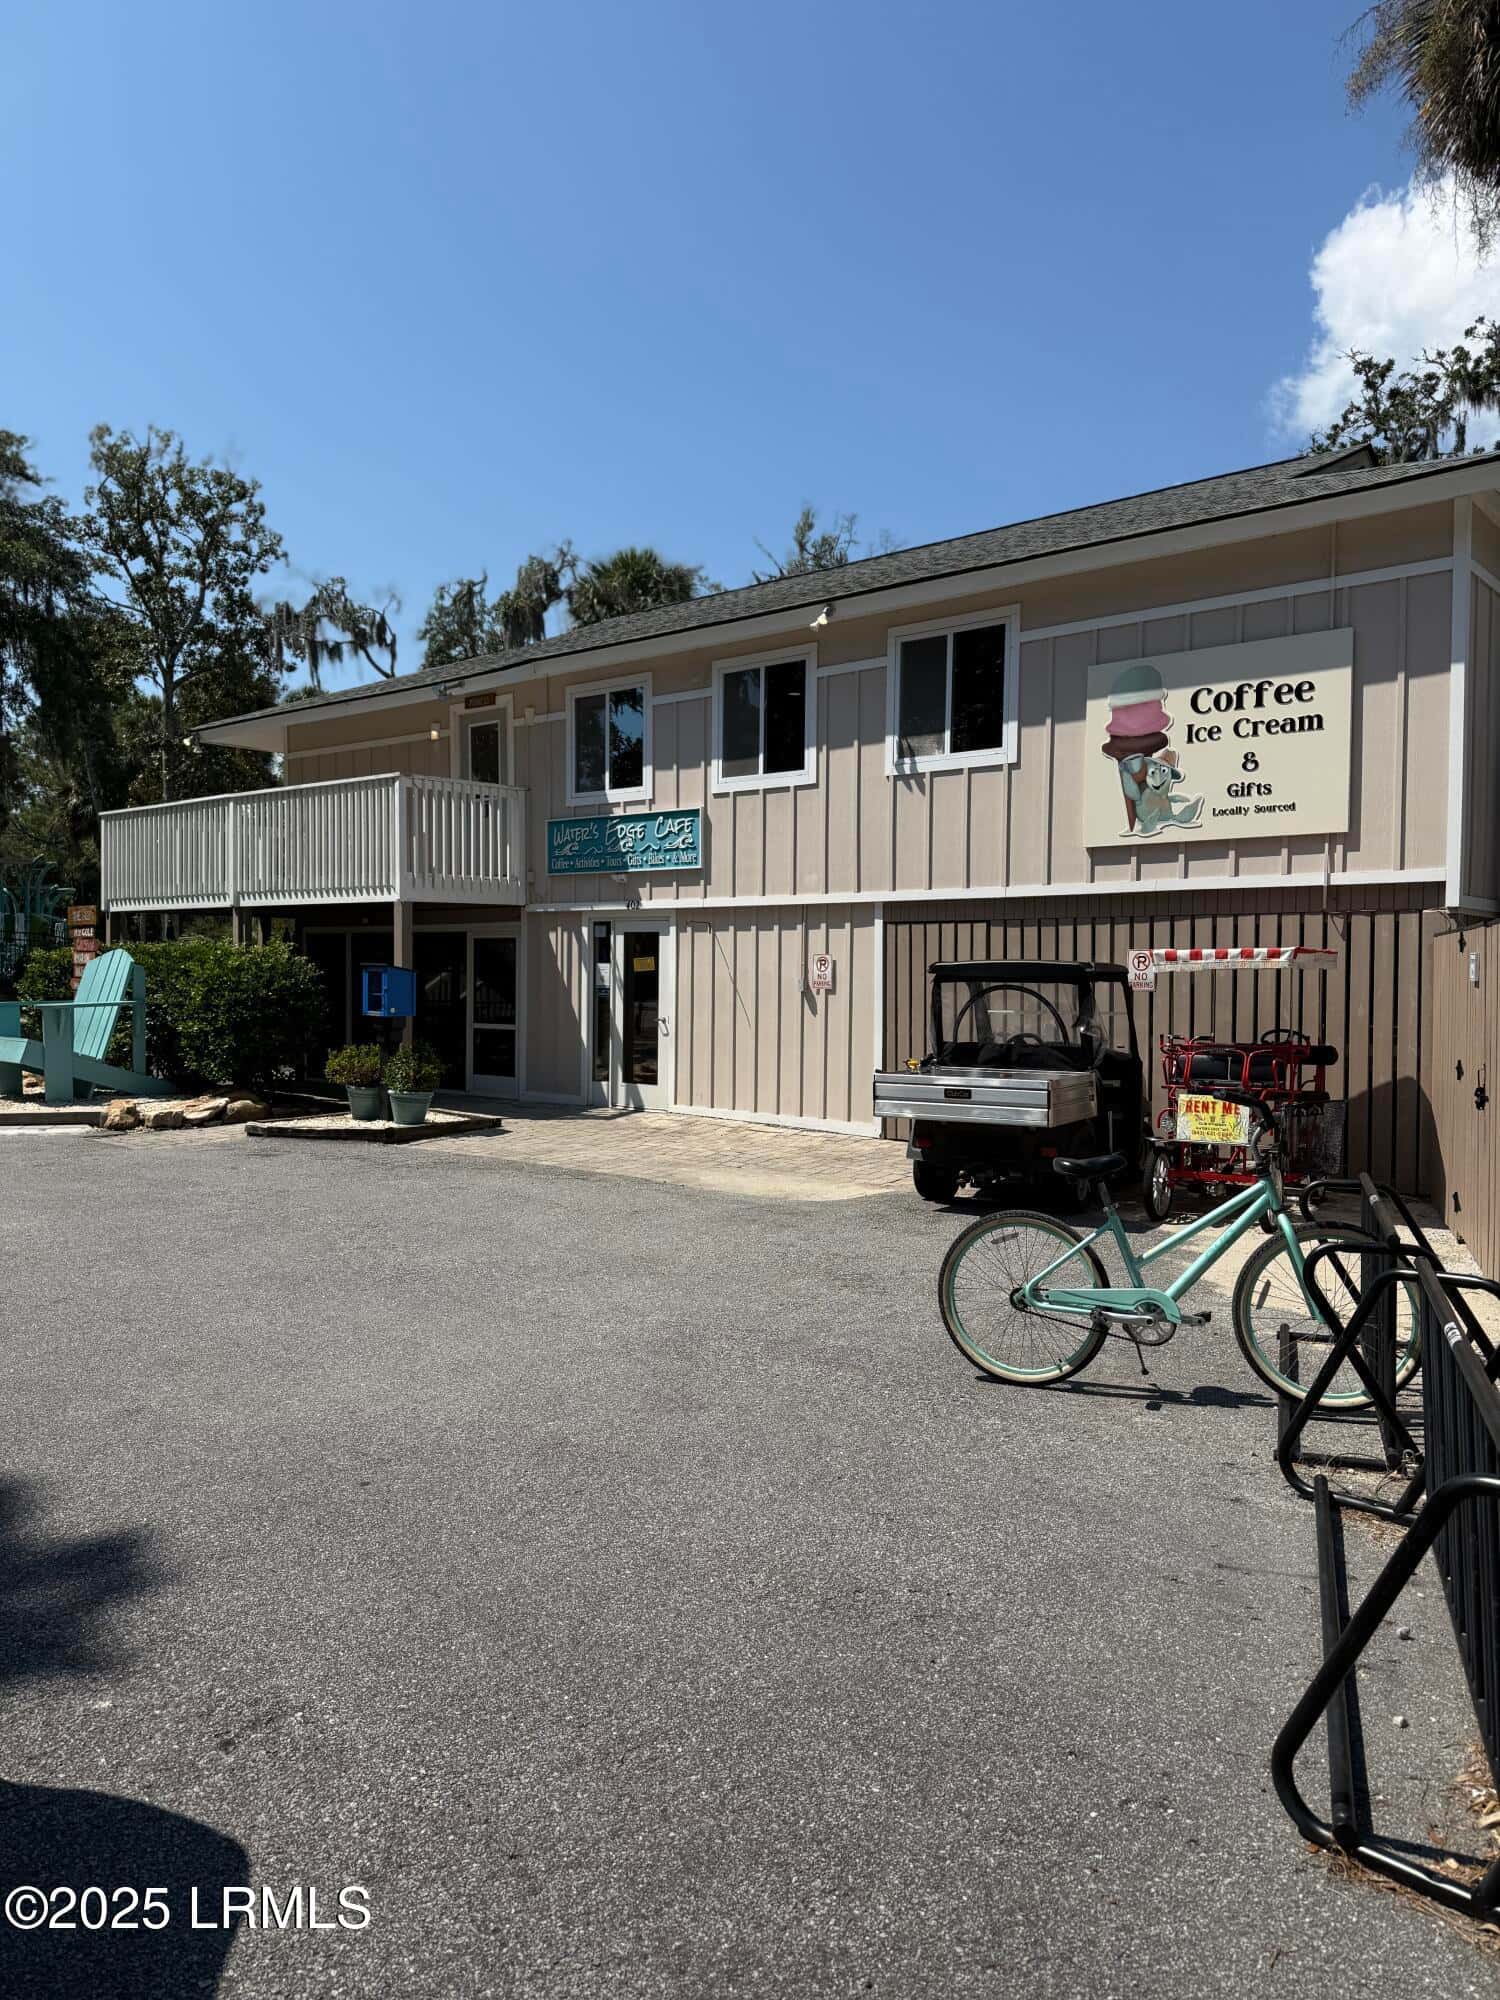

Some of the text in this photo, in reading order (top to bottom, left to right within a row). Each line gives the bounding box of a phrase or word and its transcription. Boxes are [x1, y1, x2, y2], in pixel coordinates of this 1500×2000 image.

[1190, 680, 1315, 714] Coffee
[1186, 713, 1324, 744] Ice Cream
[1241, 752, 1259, 772] &
[1226, 781, 1272, 798] Gifts
[1212, 802, 1296, 817] Locally Sourced
[605, 818, 646, 845] EDGE
[655, 816, 693, 837] CAFE
[1185, 1100, 1241, 1115] RENT ME
